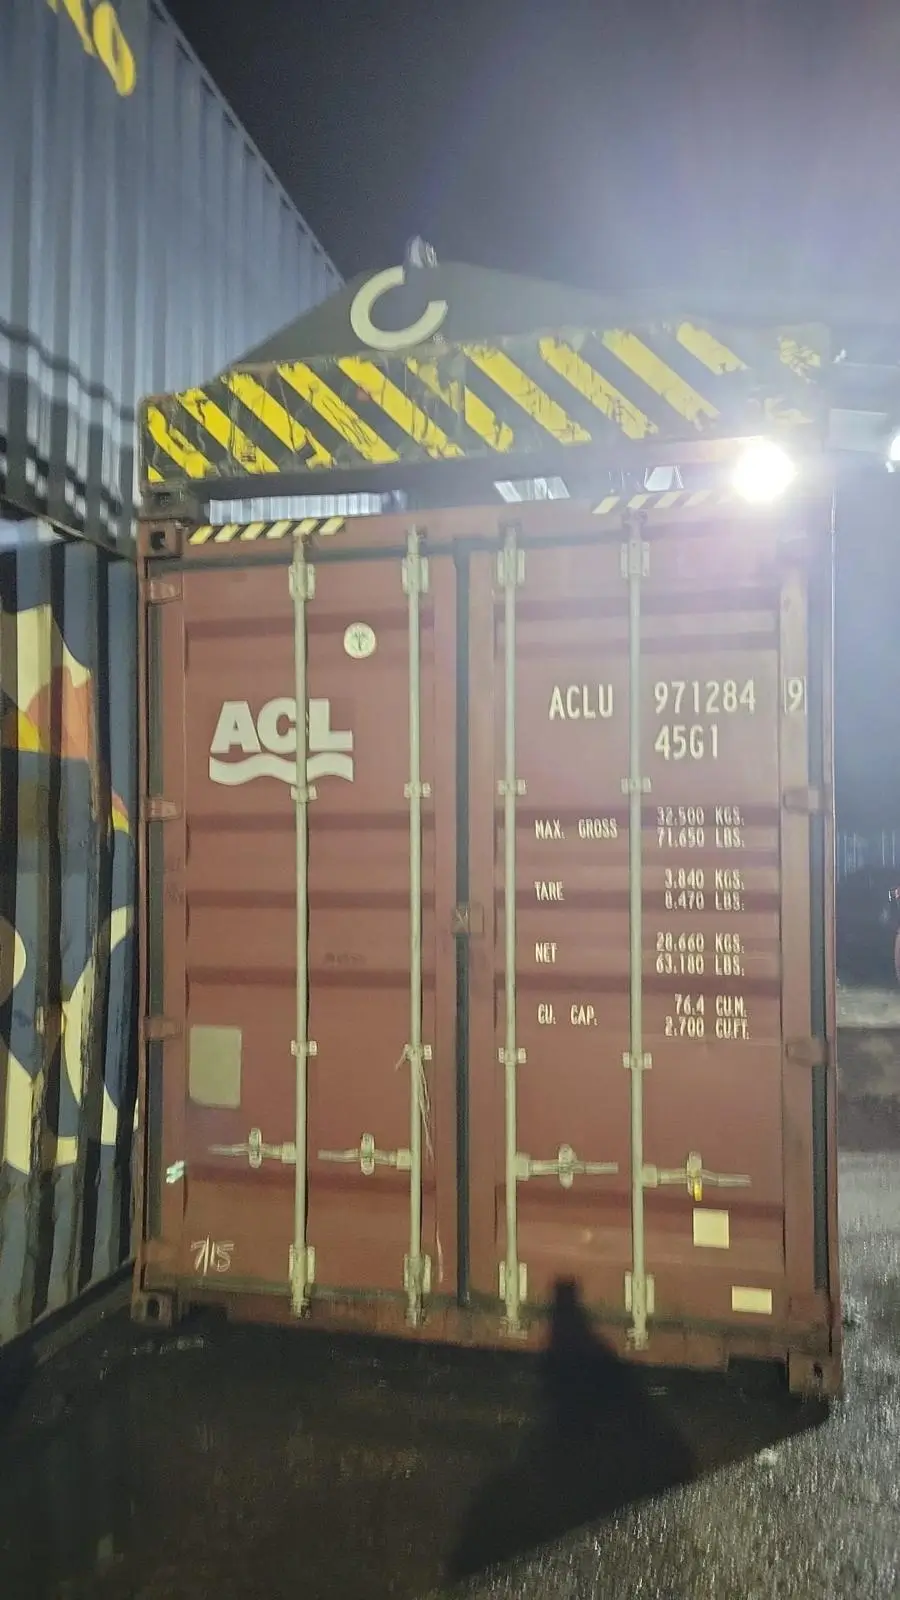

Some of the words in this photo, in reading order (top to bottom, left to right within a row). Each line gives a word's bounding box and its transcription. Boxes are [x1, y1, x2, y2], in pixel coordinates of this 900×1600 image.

[549, 683, 614, 720] ACLU
[654, 680, 756, 714] 971284
[787, 677, 803, 713] 9
[210, 697, 353, 754] ACL
[655, 724, 719, 760] 45G1
[657, 806, 704, 826] 32.500
[578, 819, 618, 839] GROSS
[657, 827, 704, 848] 71.650
[665, 868, 704, 889] 3.840
[535, 881, 564, 901] TARE
[535, 942, 558, 963] NET
[657, 932, 704, 952] 28.660
[674, 993, 704, 1015] 76.4
[665, 1016, 704, 1037] 2.700
